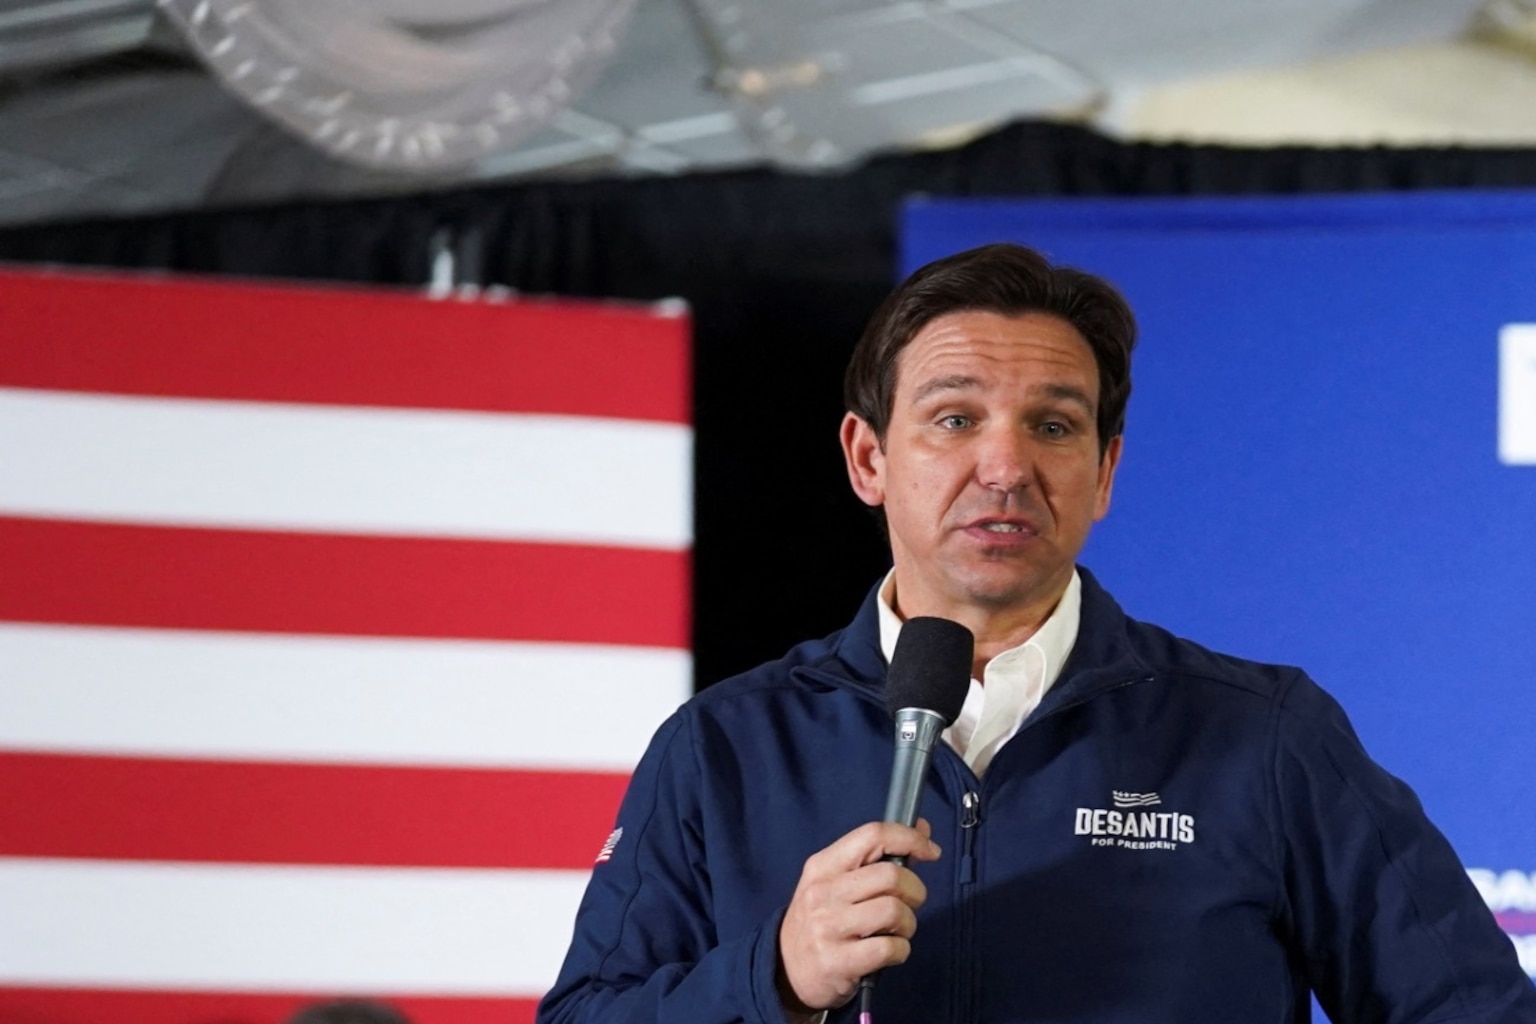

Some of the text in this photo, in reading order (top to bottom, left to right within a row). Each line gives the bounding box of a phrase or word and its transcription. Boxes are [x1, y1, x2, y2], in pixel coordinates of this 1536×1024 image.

[1074, 807, 1195, 844] DESANTIS
[1091, 837, 1177, 851] FOR PRESIDENT
